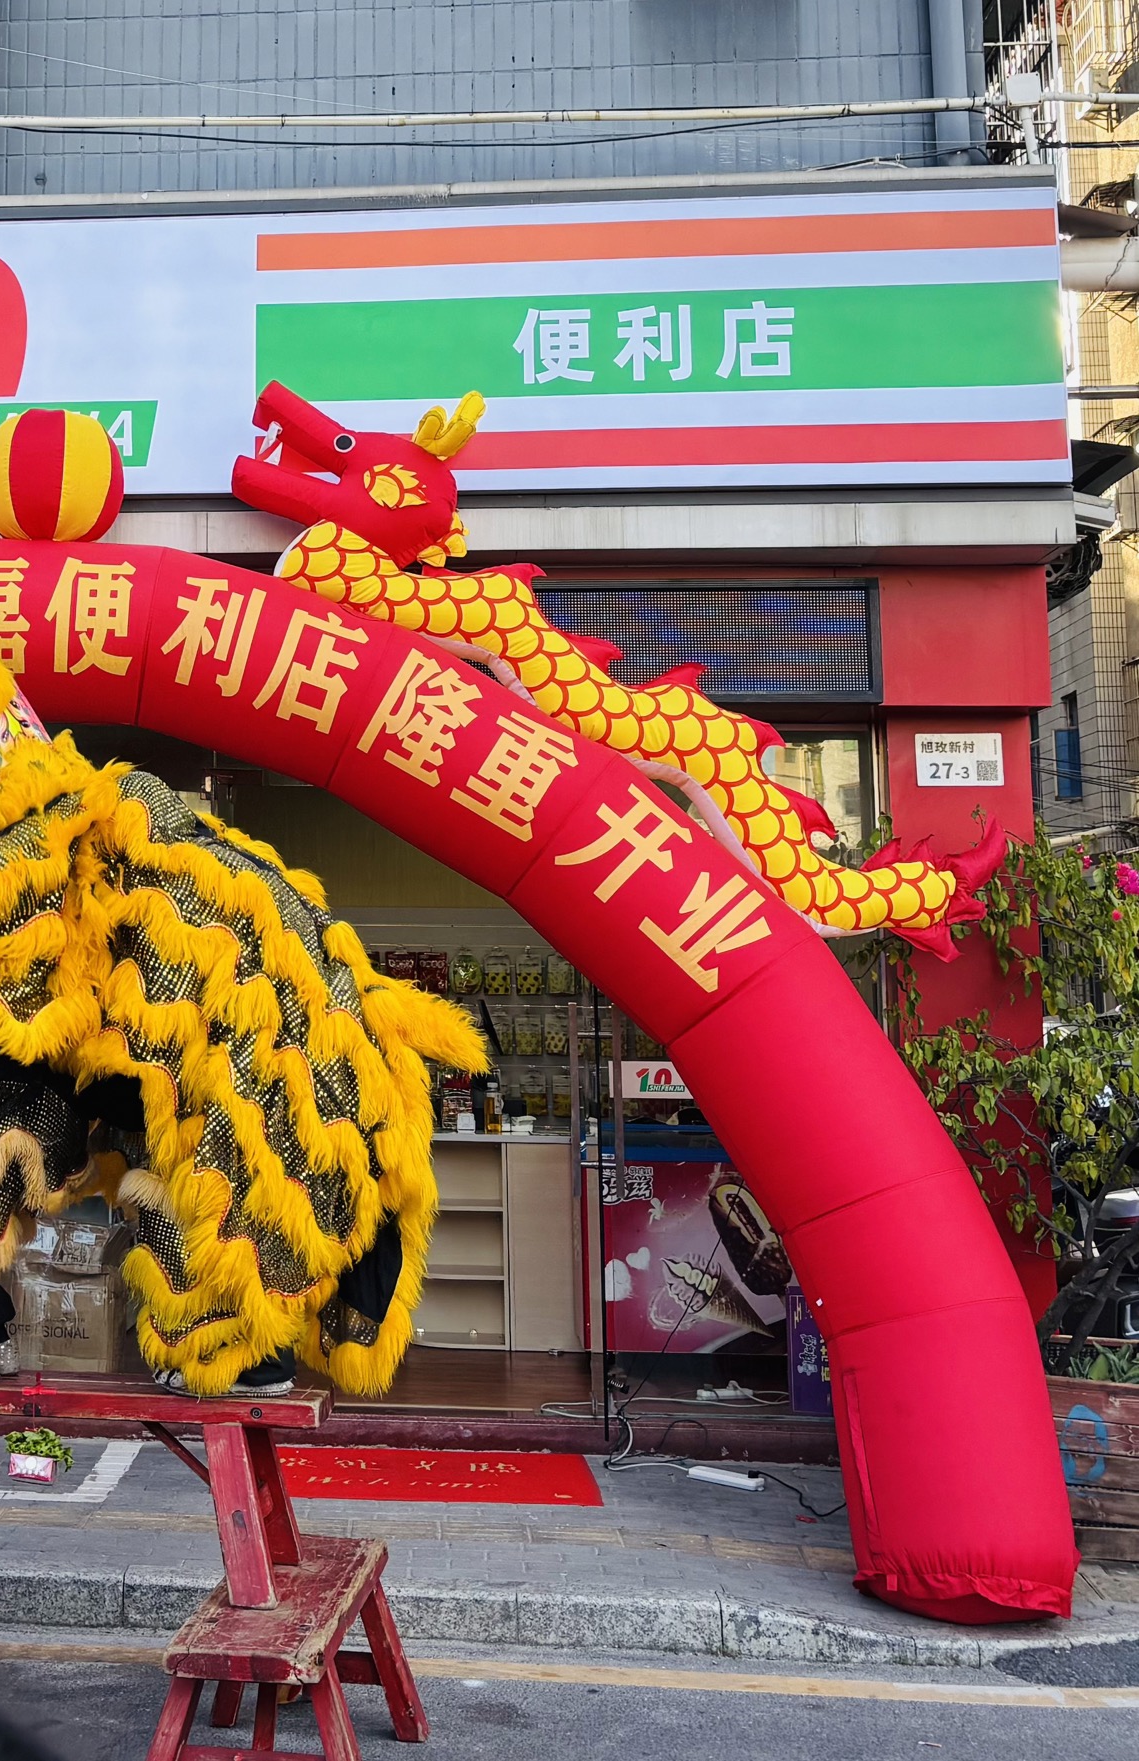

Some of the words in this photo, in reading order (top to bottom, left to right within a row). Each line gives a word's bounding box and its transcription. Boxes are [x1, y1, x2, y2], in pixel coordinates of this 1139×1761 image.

[512, 300, 795, 385] 便利店
[920, 740, 975, 754] 旭玫新村
[929, 762, 970, 780] 27-3
[635, 1067, 673, 1093] 10
